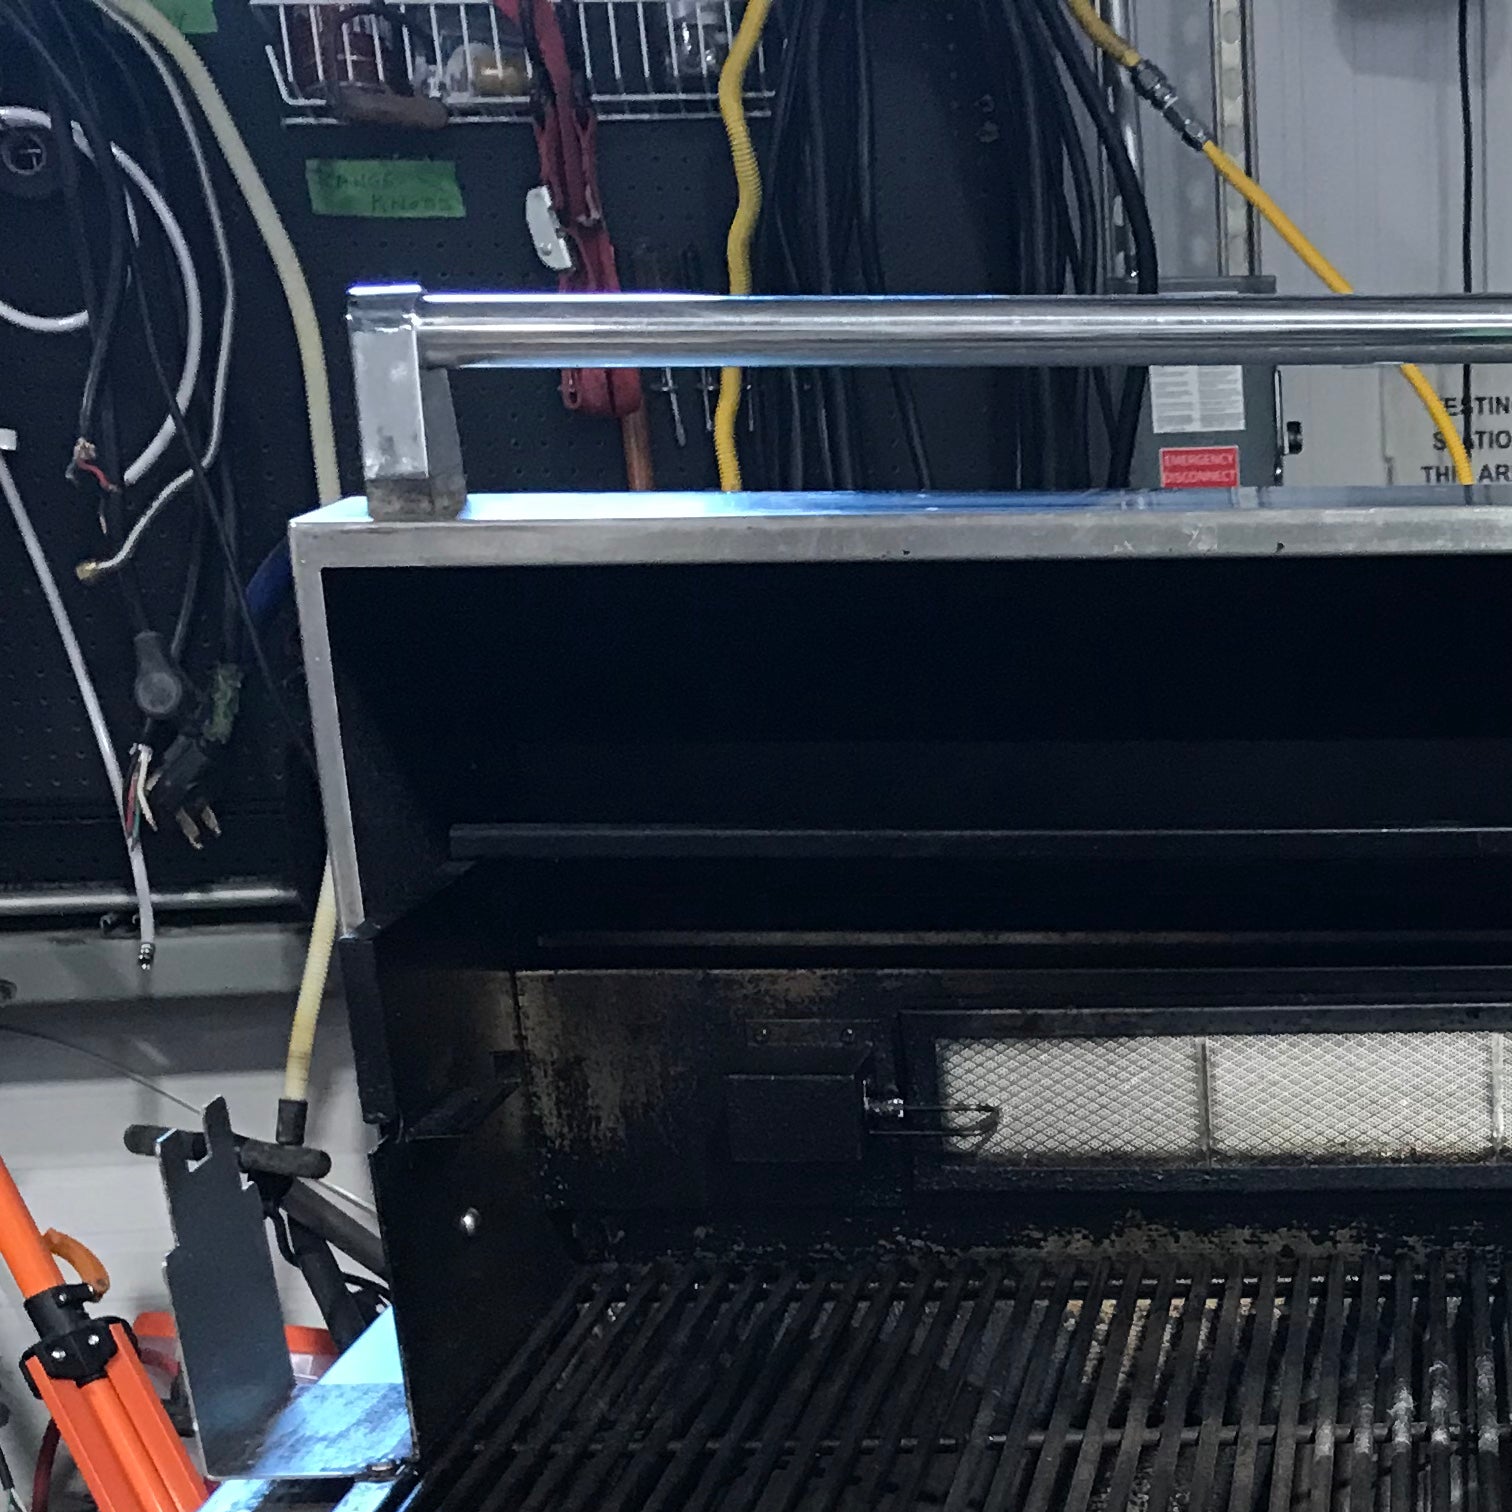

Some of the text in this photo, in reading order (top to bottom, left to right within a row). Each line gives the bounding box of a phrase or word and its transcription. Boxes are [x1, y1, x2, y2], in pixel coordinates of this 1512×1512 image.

[1164, 453, 1234, 466] EMERGENCY
[1164, 470, 1236, 484] DISCONNECT
[1420, 465, 1457, 484] THI
